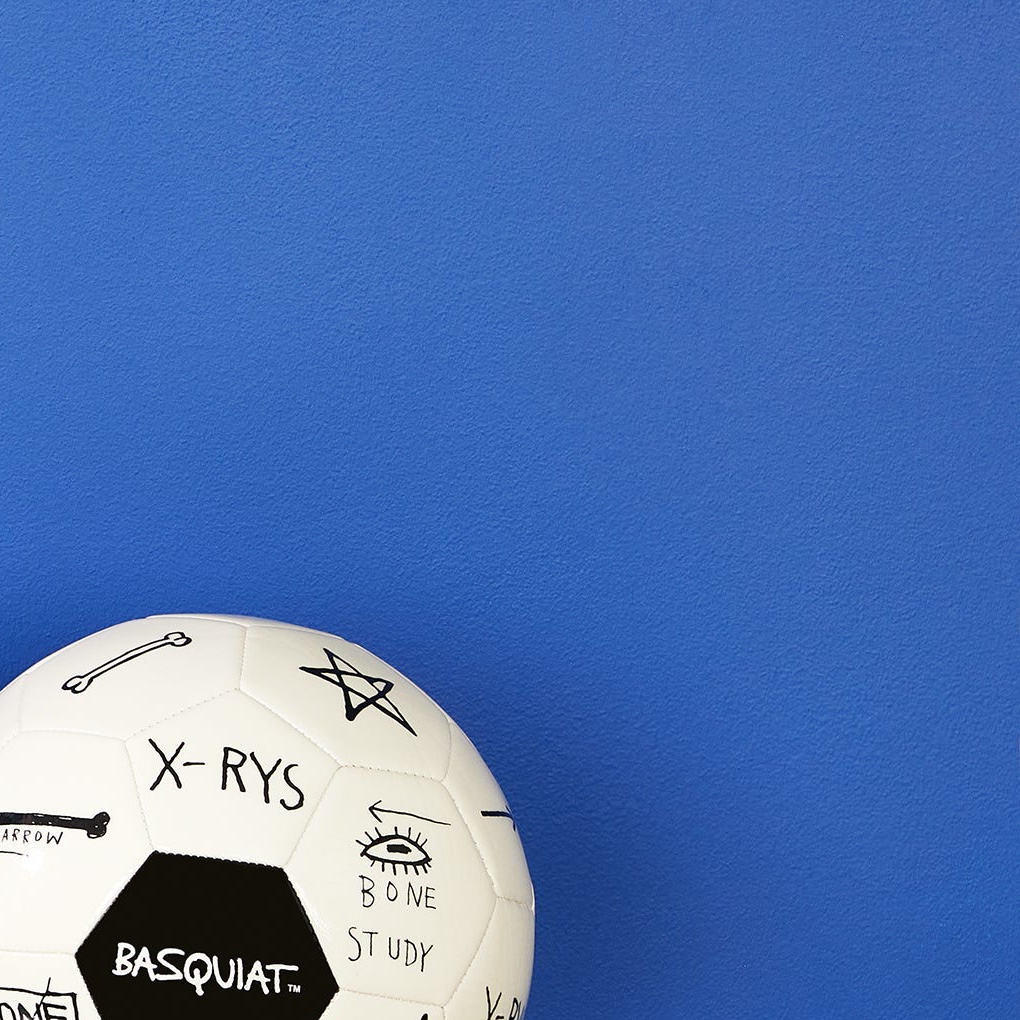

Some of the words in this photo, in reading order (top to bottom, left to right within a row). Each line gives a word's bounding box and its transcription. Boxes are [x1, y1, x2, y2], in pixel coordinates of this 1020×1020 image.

[359, 875, 437, 909] BONE
[111, 942, 299, 996] BASQUIAT
[348, 926, 434, 973] STUDY
